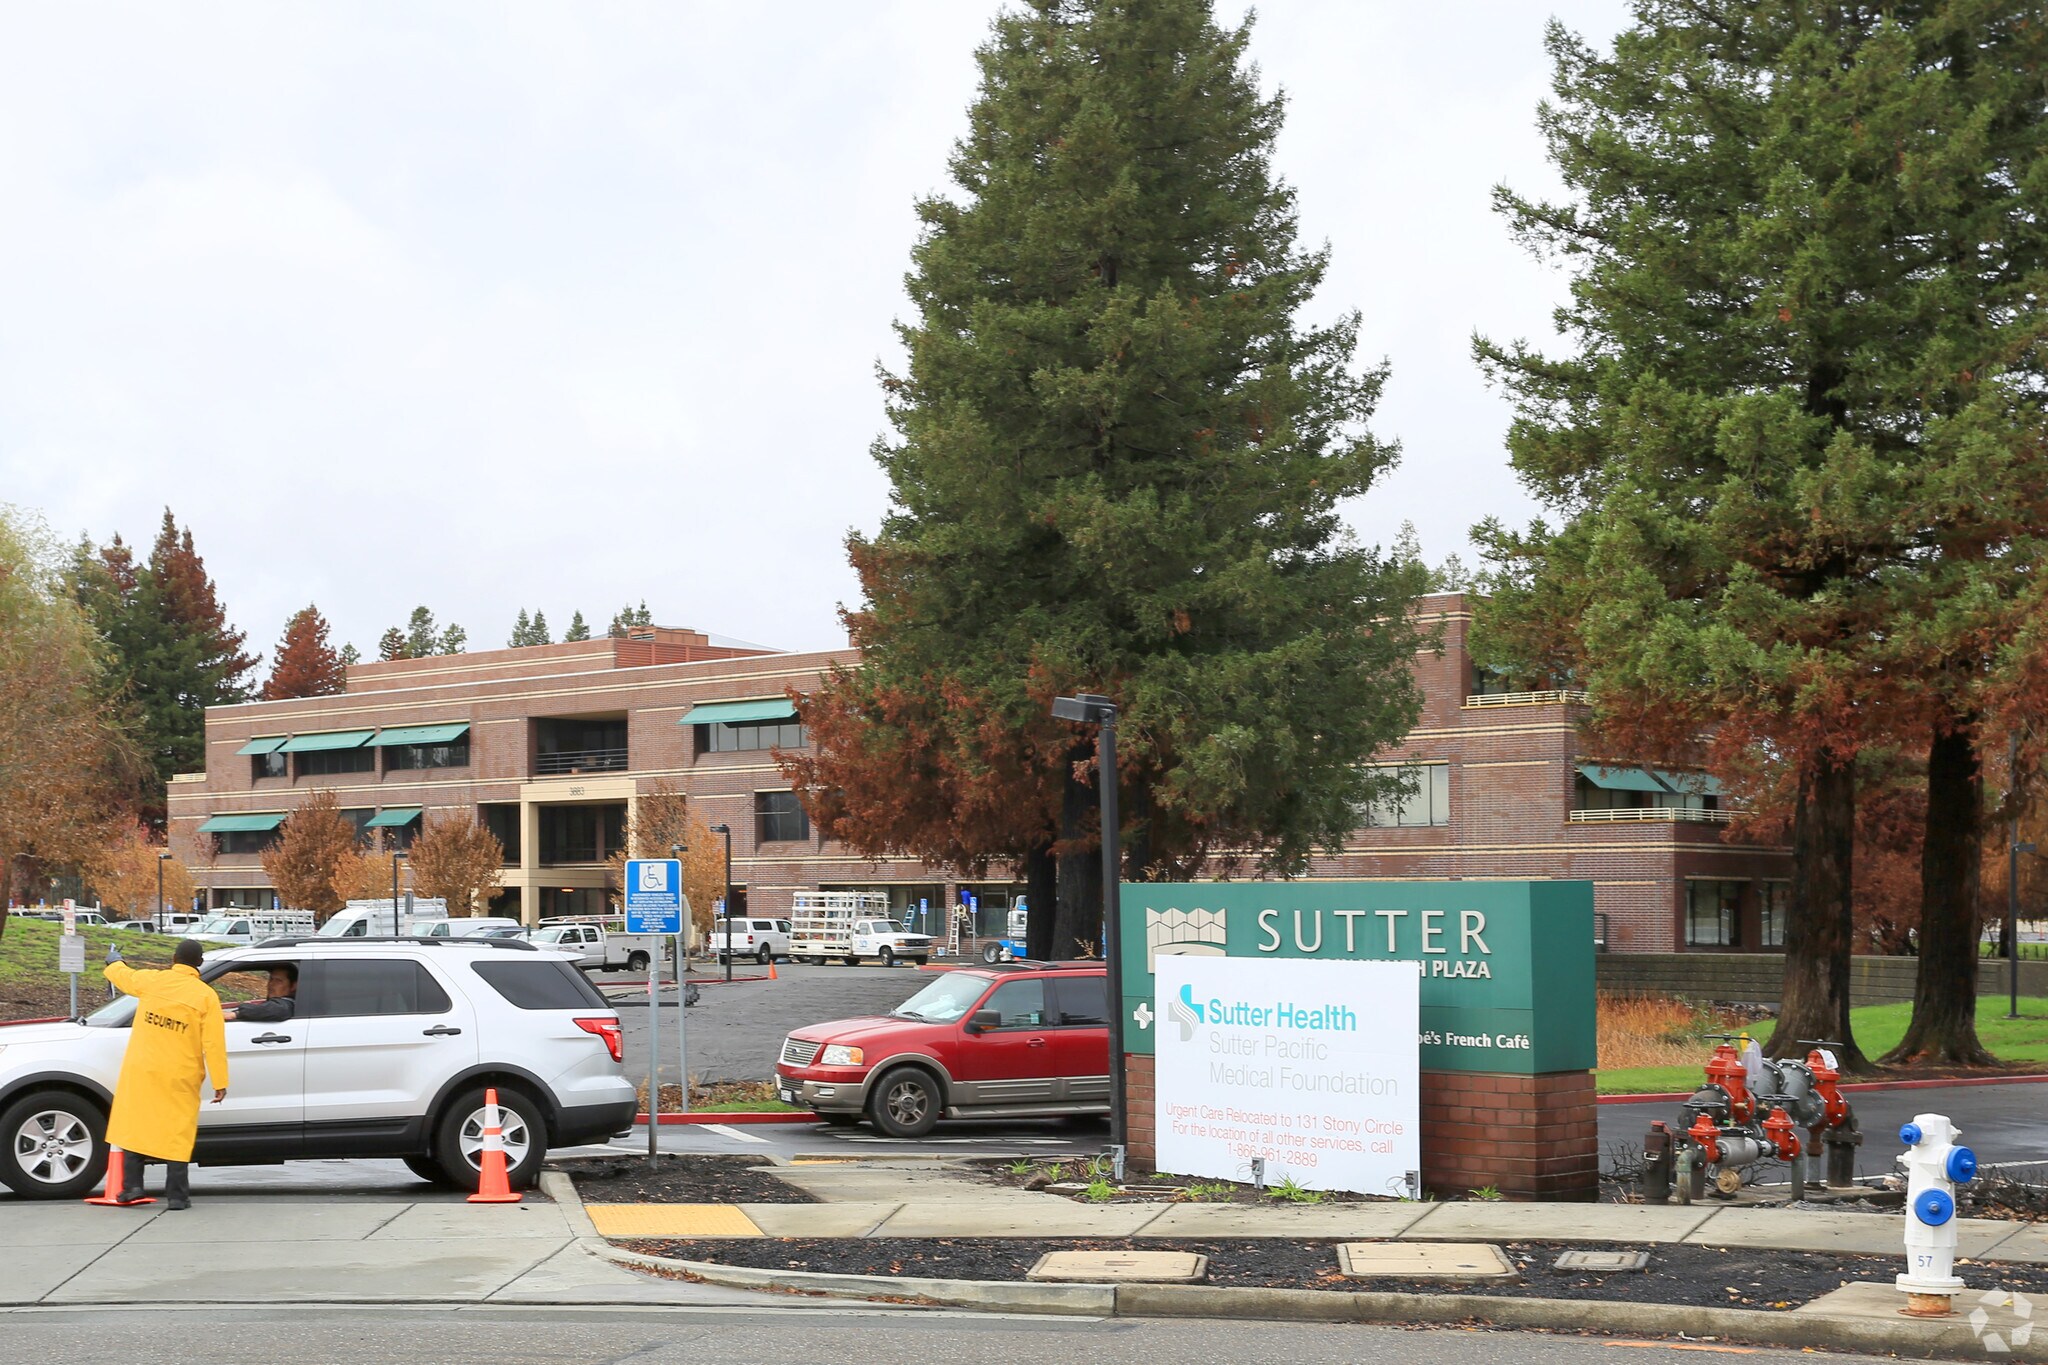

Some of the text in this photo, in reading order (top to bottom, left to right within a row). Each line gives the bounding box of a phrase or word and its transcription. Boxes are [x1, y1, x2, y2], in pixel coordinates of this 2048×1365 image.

[1258, 909, 1491, 954] SUTTER
[1432, 960, 1491, 978] PLAZA
[144, 1011, 189, 1034] SECURITY
[1209, 998, 1356, 1031] Sutter Health
[1210, 1031, 1328, 1060] Sutter Pacific
[1446, 1033, 1491, 1047] French
[1496, 1035, 1530, 1049] Café
[1210, 1062, 1398, 1096] Medical Foundation
[1166, 1103, 1403, 1135] Urgent Care Relocated to 131 Stony Circle
[1172, 1121, 1393, 1153] For the location of all other services, call
[1227, 1143, 1317, 1167] 1-866-961-2889
[1918, 1255, 1933, 1268] 57
